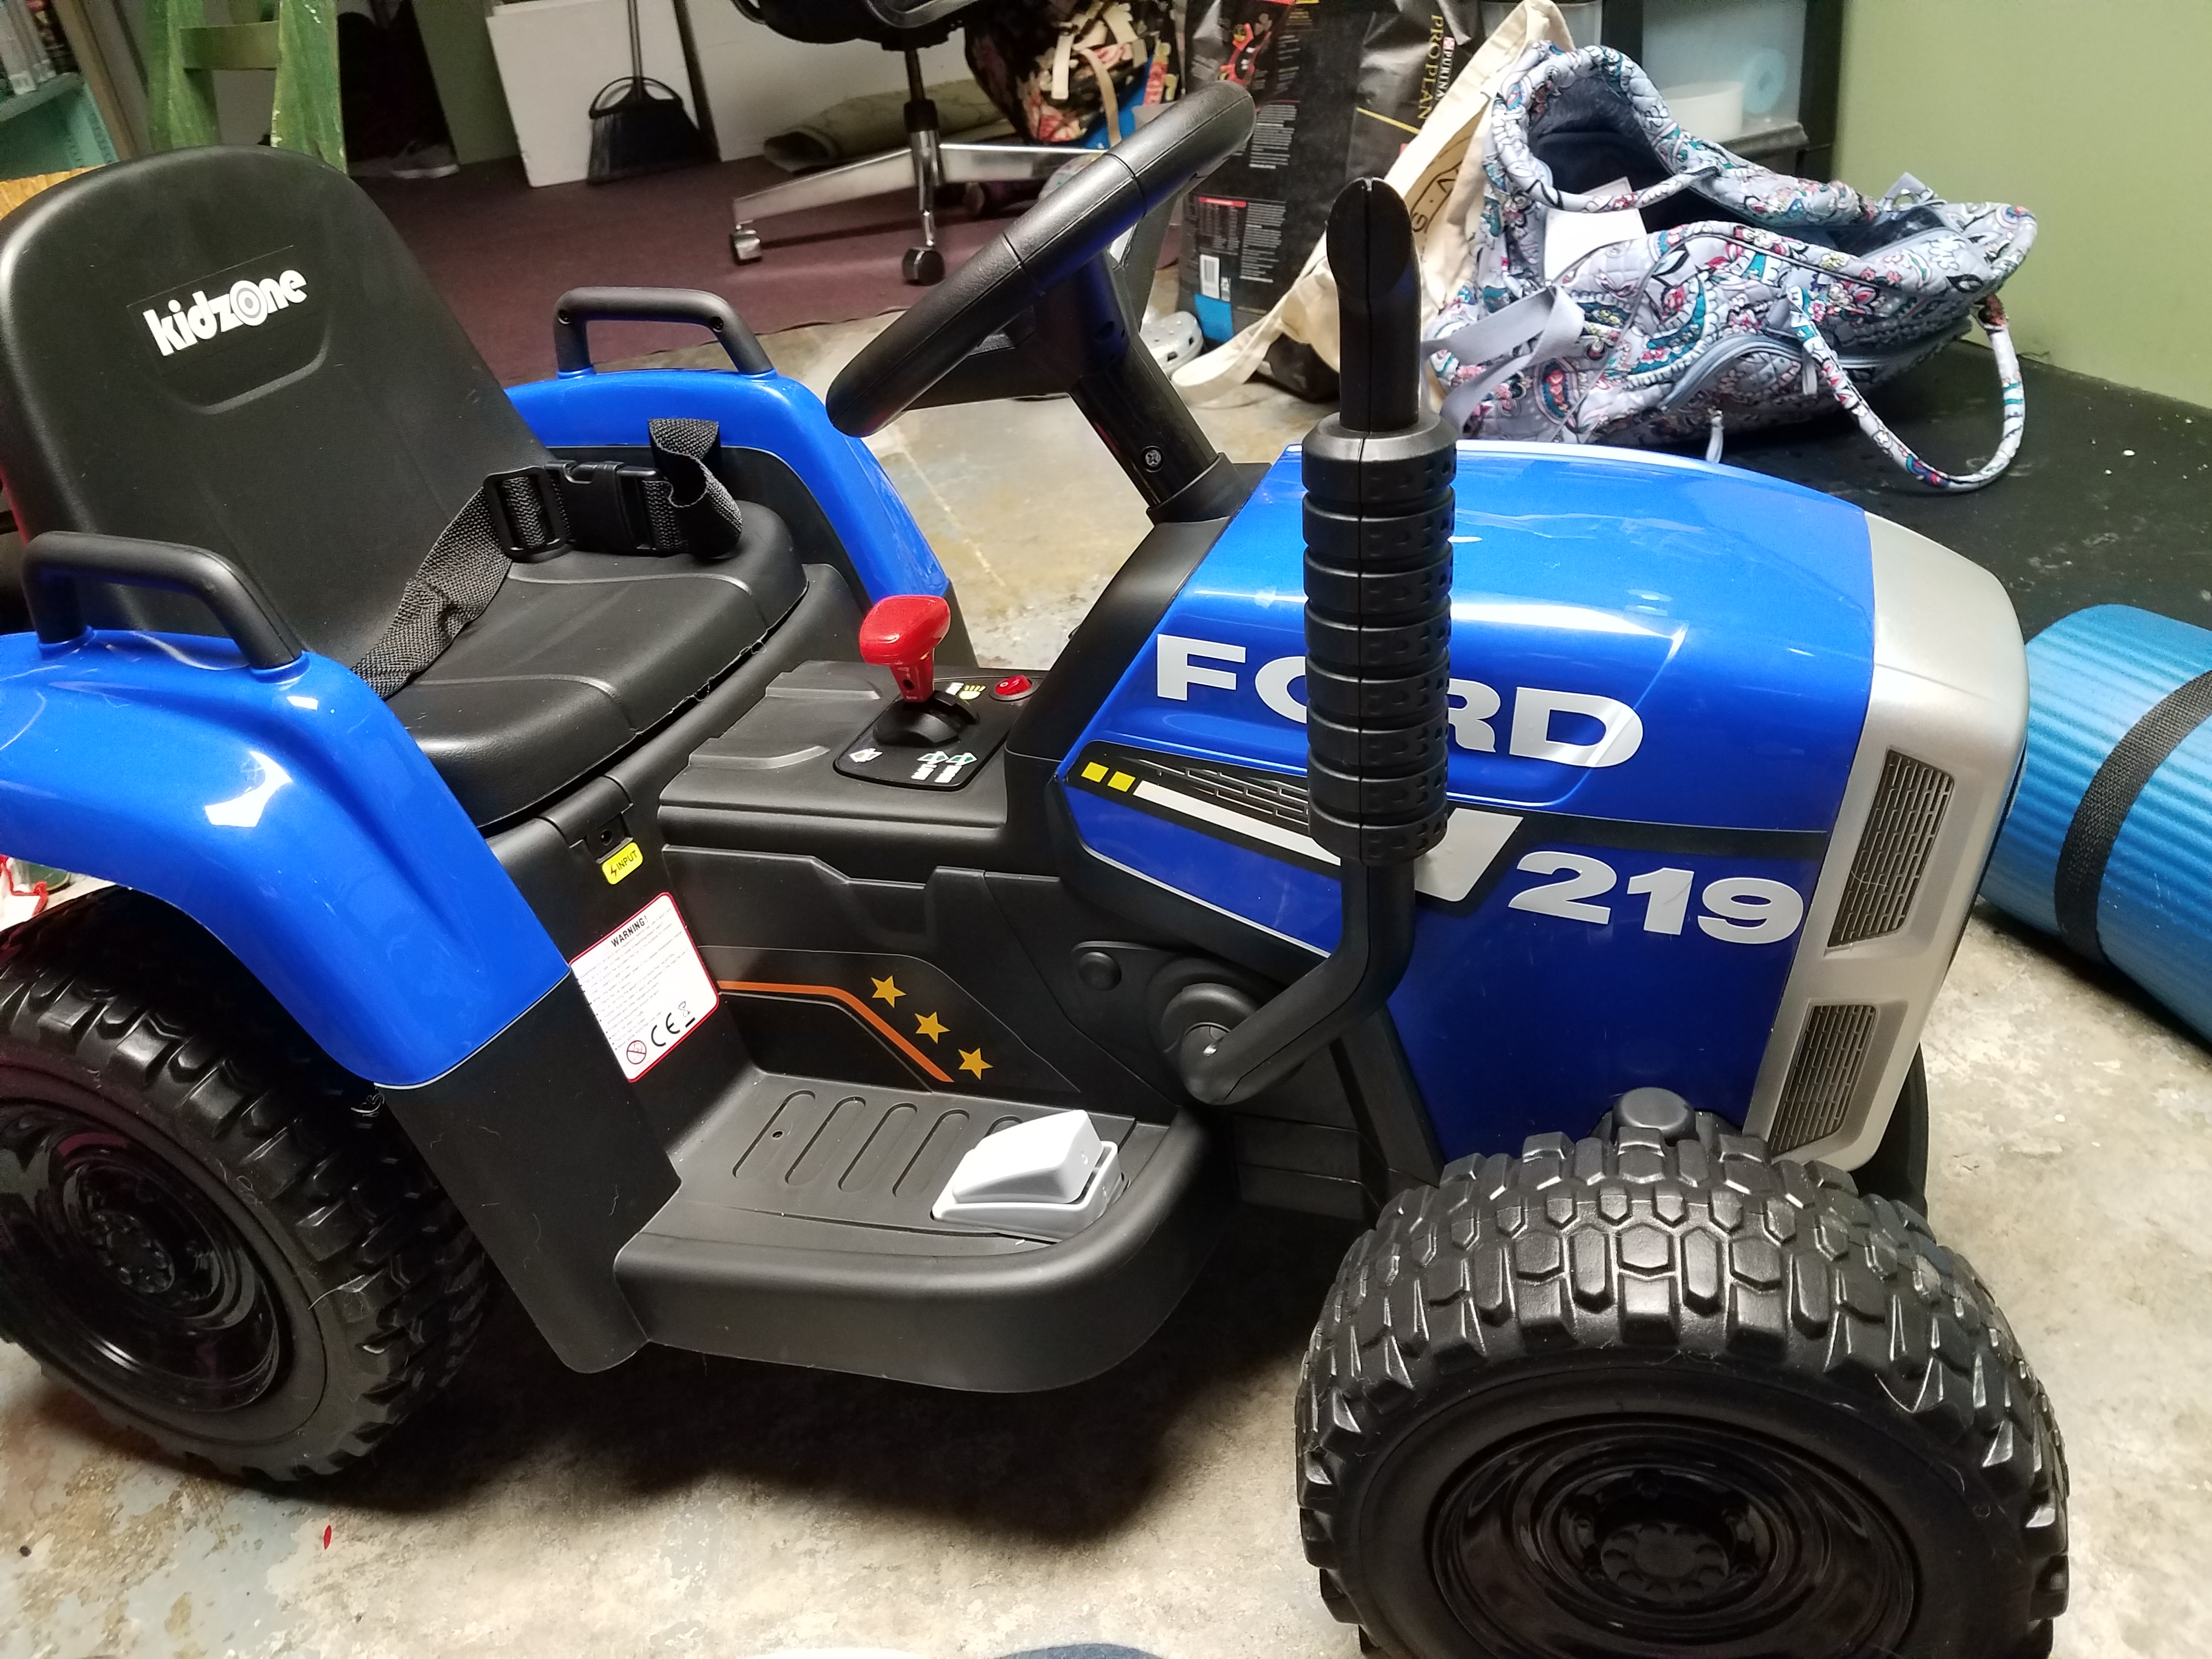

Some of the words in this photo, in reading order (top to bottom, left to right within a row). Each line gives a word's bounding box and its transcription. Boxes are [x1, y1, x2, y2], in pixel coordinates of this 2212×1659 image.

[1428, 14, 1443, 59] PRO
[1418, 64, 1438, 119] PLAN
[1435, 50, 1453, 100] PURINA
[616, 850, 637, 871] INPUT
[1508, 851, 1804, 944] 219
